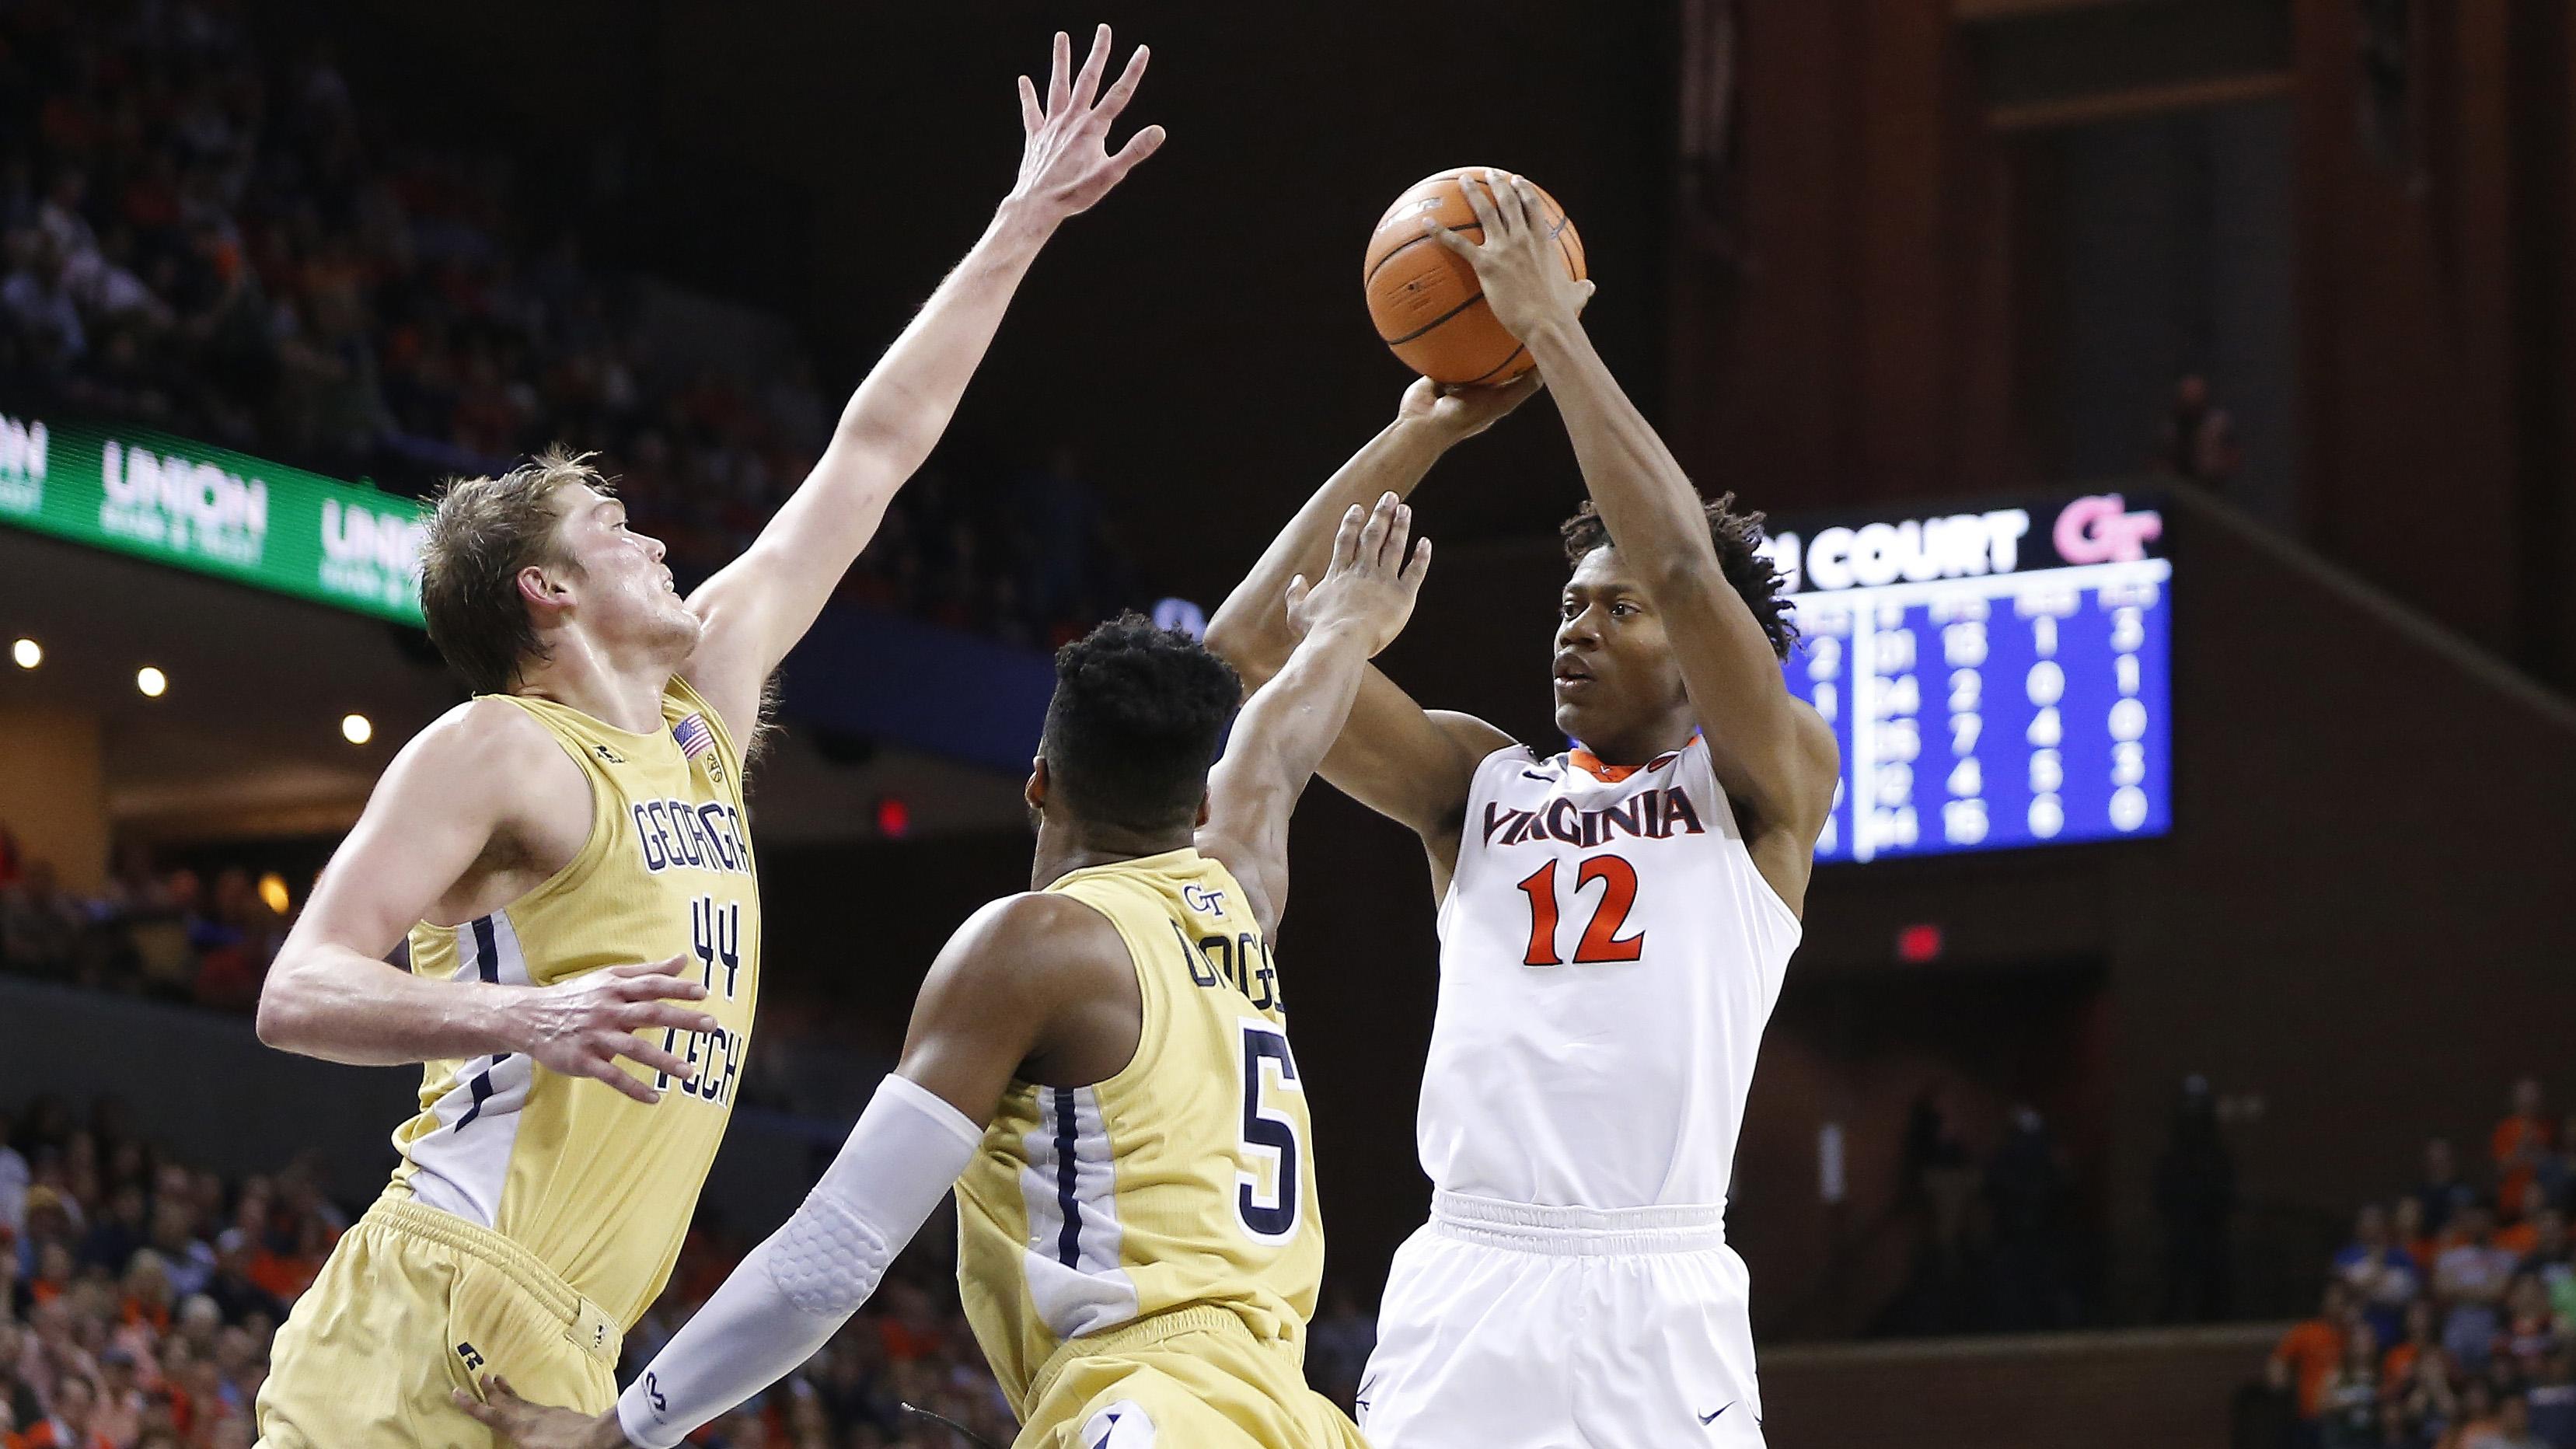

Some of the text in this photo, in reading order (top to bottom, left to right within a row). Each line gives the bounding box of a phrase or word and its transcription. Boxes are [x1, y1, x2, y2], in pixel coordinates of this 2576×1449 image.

[101, 440, 267, 535] UNION
[1807, 508, 2030, 591] COURT
[2026, 660, 2065, 707] 0
[2107, 698, 2148, 742] 0
[1483, 785, 1706, 849] VIRGINIA
[2107, 785, 2148, 832] 0
[1183, 883, 1225, 917] GT
[1517, 854, 1646, 966] 12
[691, 892, 741, 1002] 44
[1234, 1016, 1303, 1247] 5
